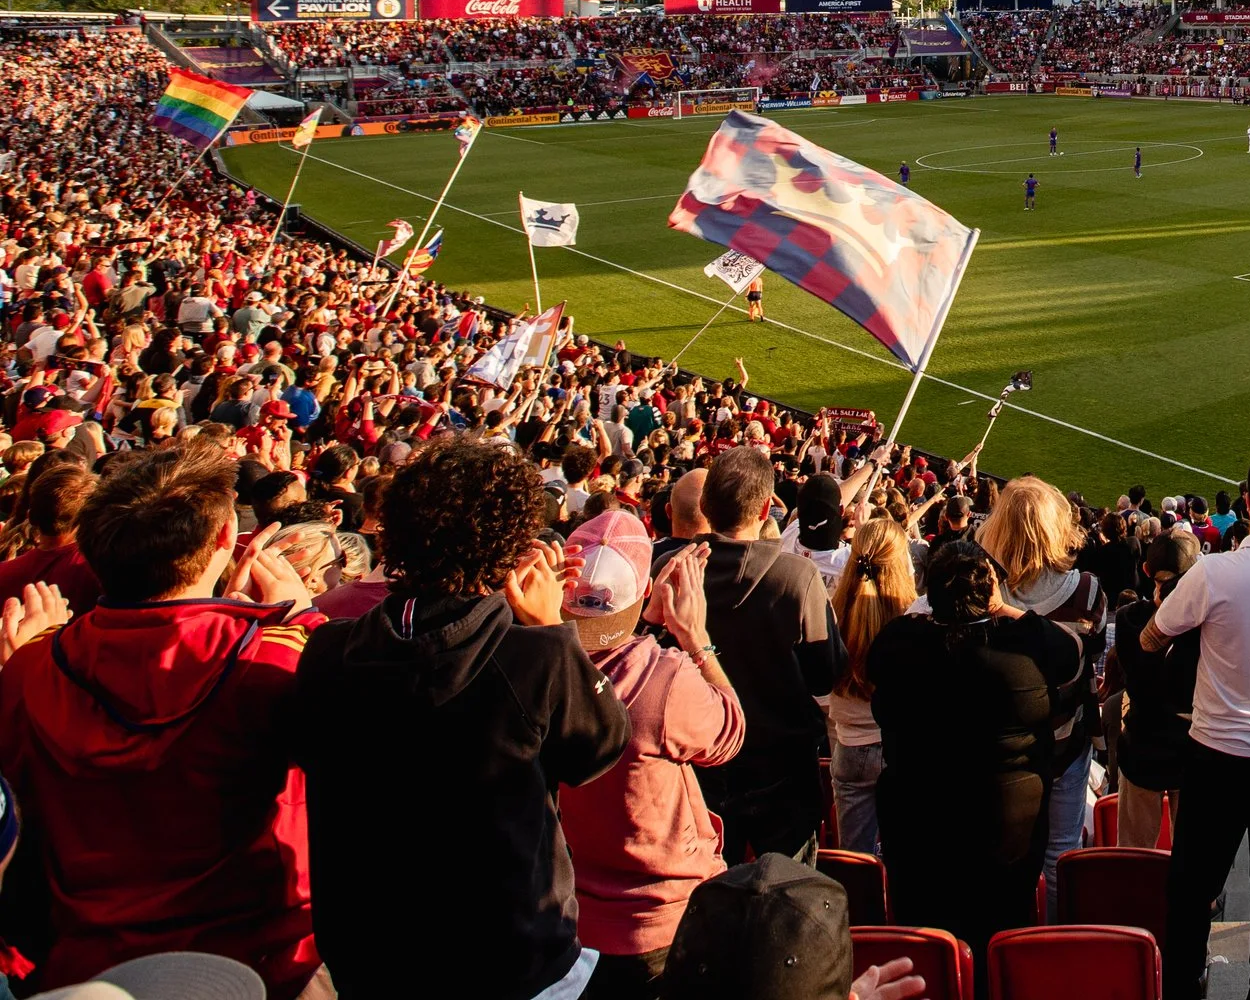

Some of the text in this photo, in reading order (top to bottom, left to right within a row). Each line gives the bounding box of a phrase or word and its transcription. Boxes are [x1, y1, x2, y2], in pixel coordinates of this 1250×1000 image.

[297, 3, 372, 12] PAVILION
[1009, 83, 1044, 91] BELVE
[694, 103, 733, 113] Continental
[760, 99, 812, 109] SHERWIN-WILLIAMS
[648, 107, 675, 117] Coca-Cola
[487, 114, 532, 126] Continental
